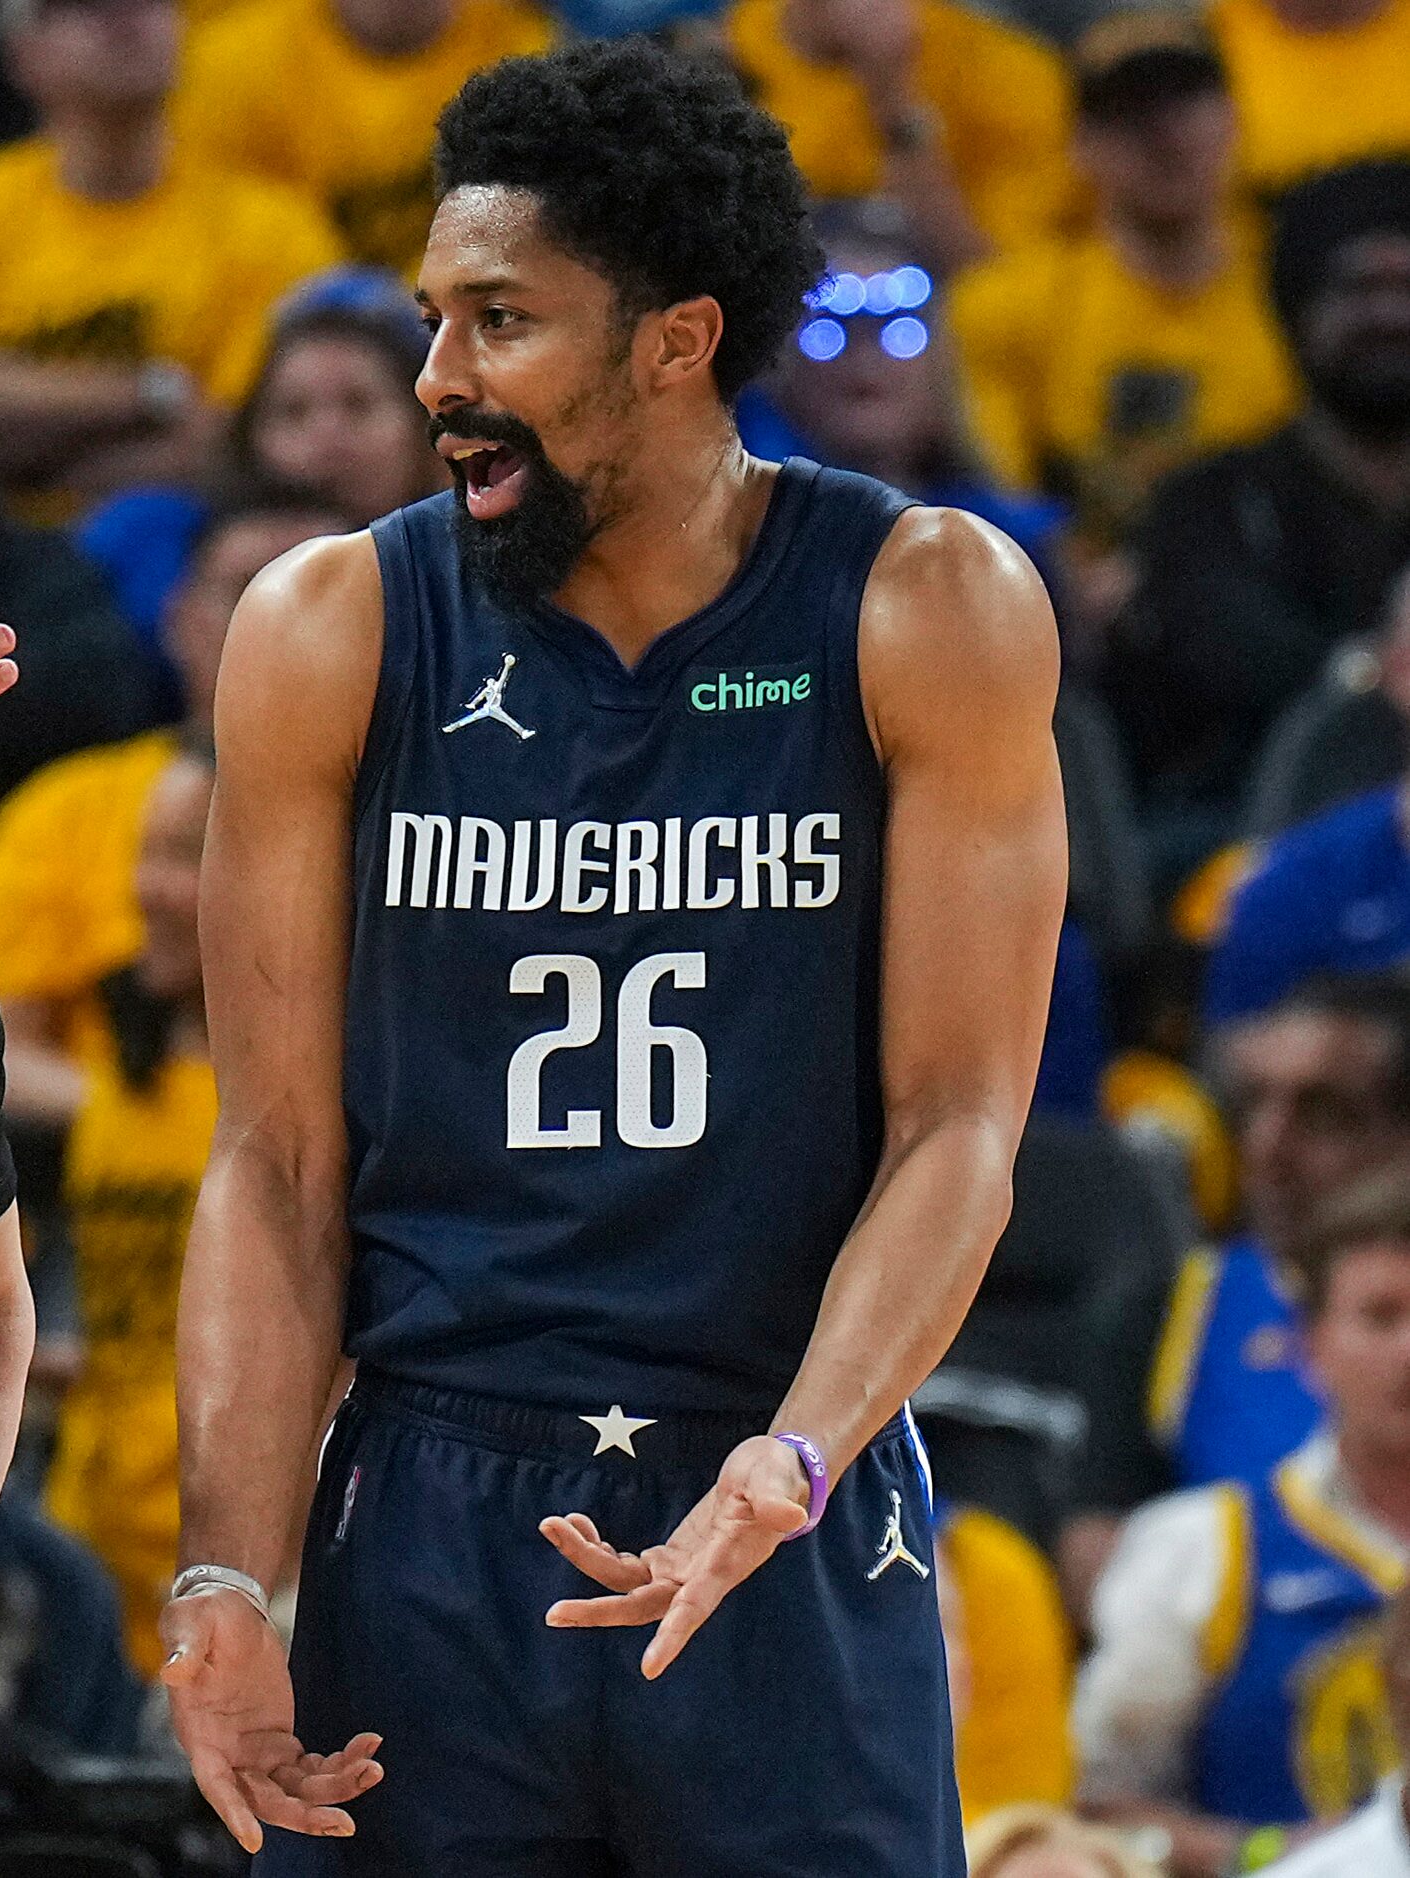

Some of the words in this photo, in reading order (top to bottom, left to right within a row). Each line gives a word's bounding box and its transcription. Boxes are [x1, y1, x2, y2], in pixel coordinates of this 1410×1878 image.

[691, 672, 810, 711] chime
[386, 812, 840, 914] MAVERICKS
[506, 951, 708, 1149] 26
